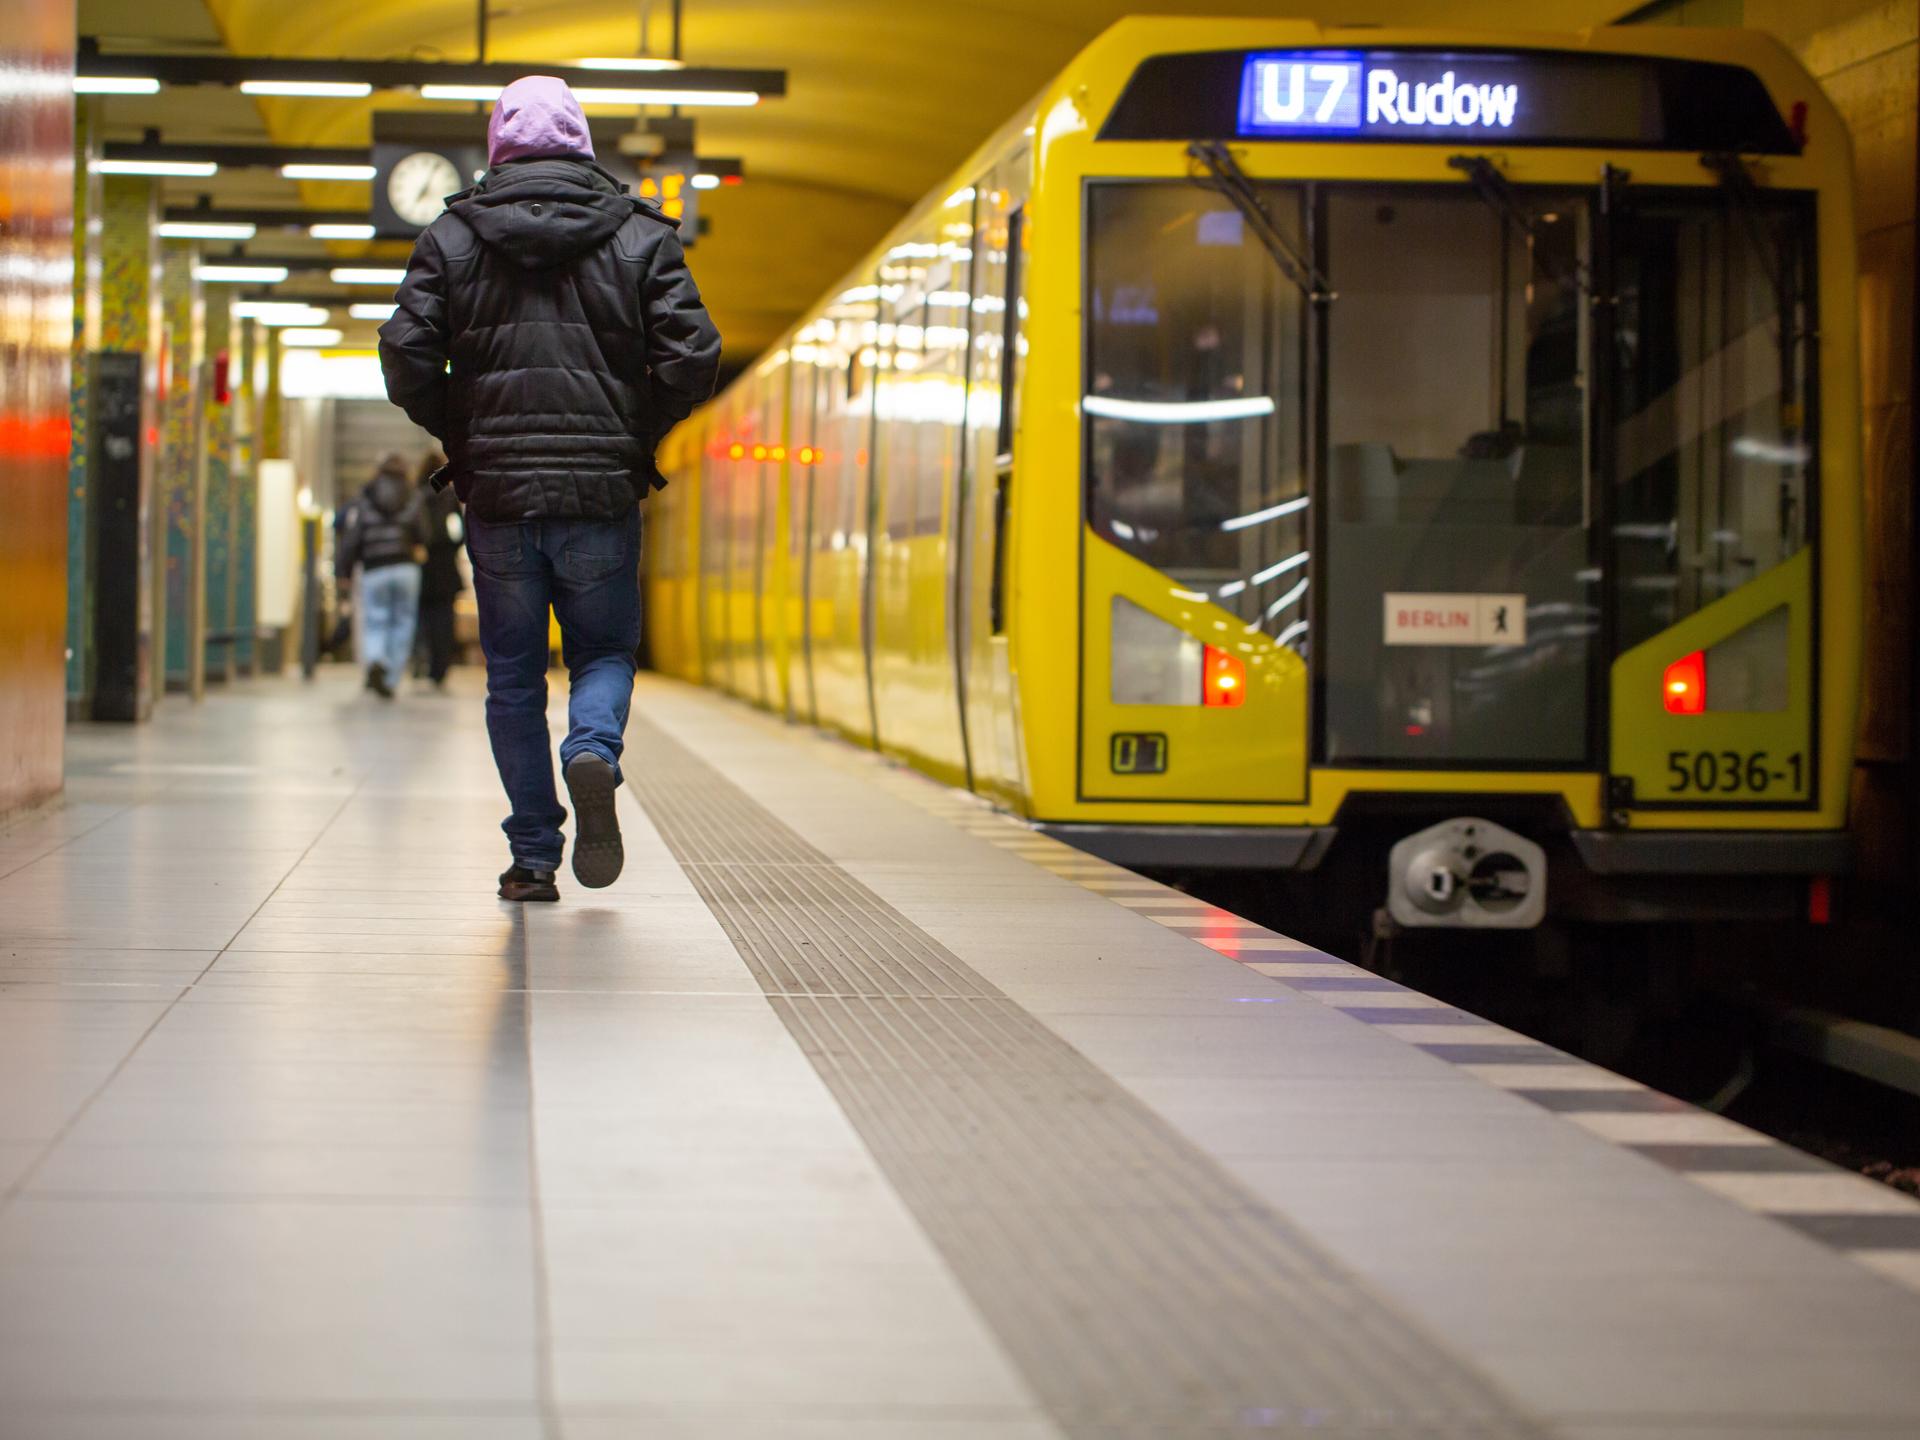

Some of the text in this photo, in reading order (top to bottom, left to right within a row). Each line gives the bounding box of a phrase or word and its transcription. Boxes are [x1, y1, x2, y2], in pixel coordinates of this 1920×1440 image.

[1263, 64, 1518, 126] U7 Rudow
[1397, 609, 1470, 628] BERLIN
[1668, 752, 1802, 792] 5036-1
